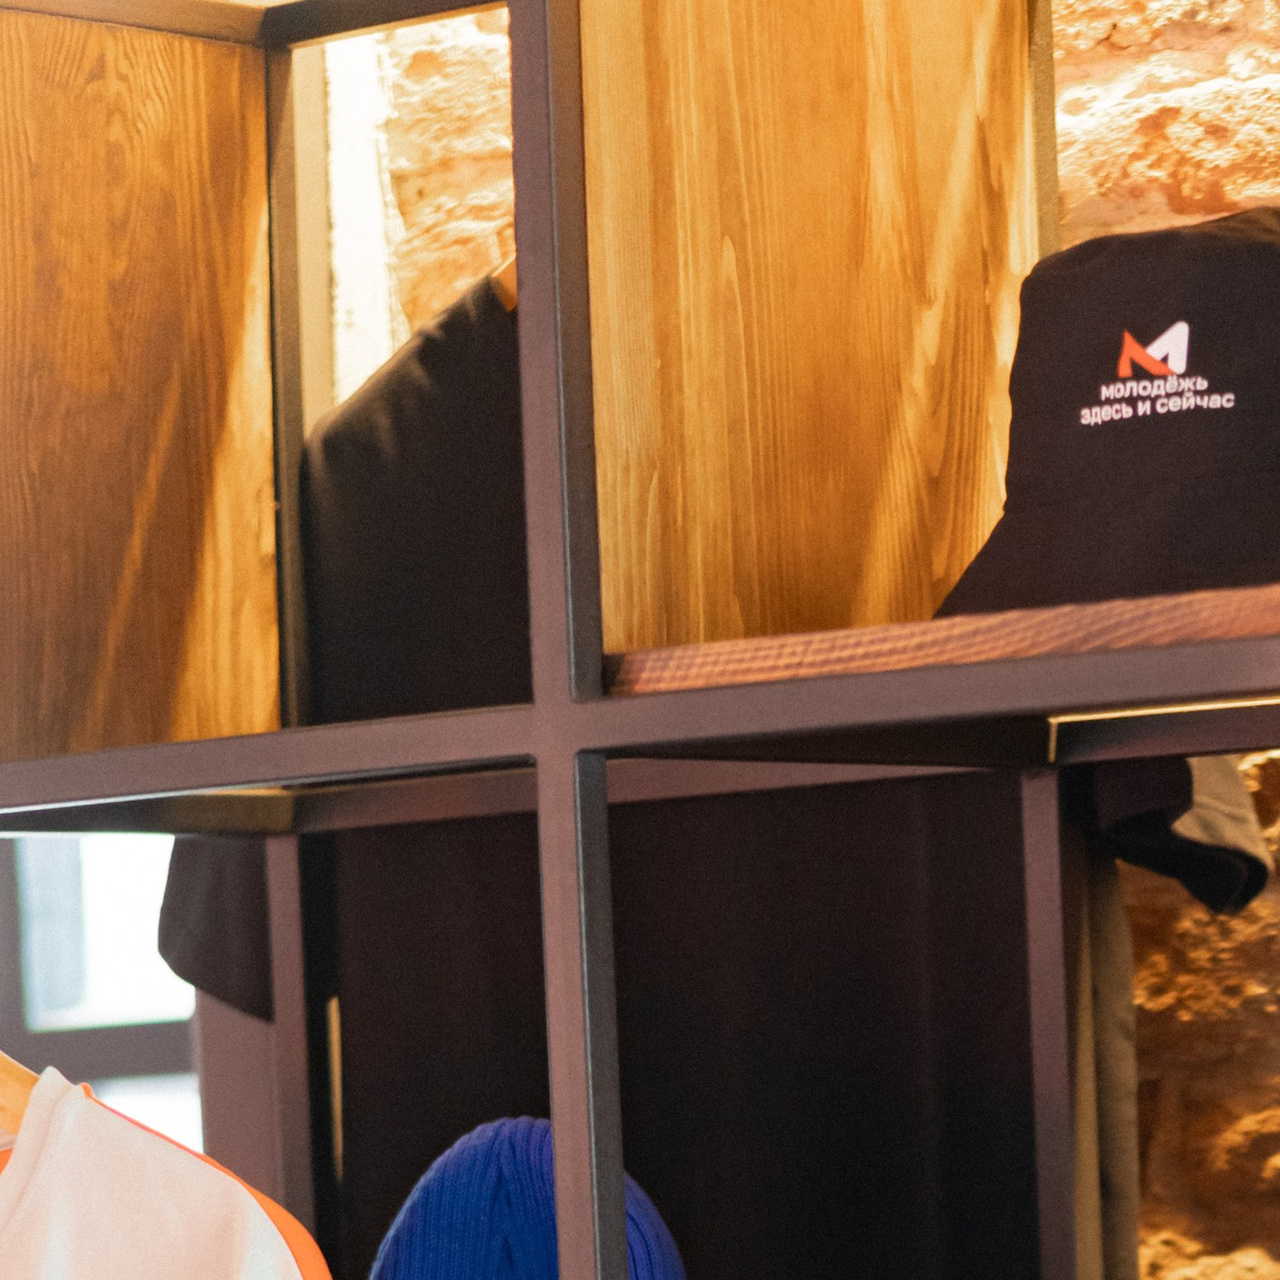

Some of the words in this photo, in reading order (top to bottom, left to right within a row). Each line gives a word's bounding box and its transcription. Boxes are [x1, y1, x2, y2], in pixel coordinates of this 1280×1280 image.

[1100, 374, 1208, 402] молодёжь
[1080, 402, 1134, 426] здесь
[1138, 401, 1151, 416] и
[1155, 391, 1236, 415] сейчас
